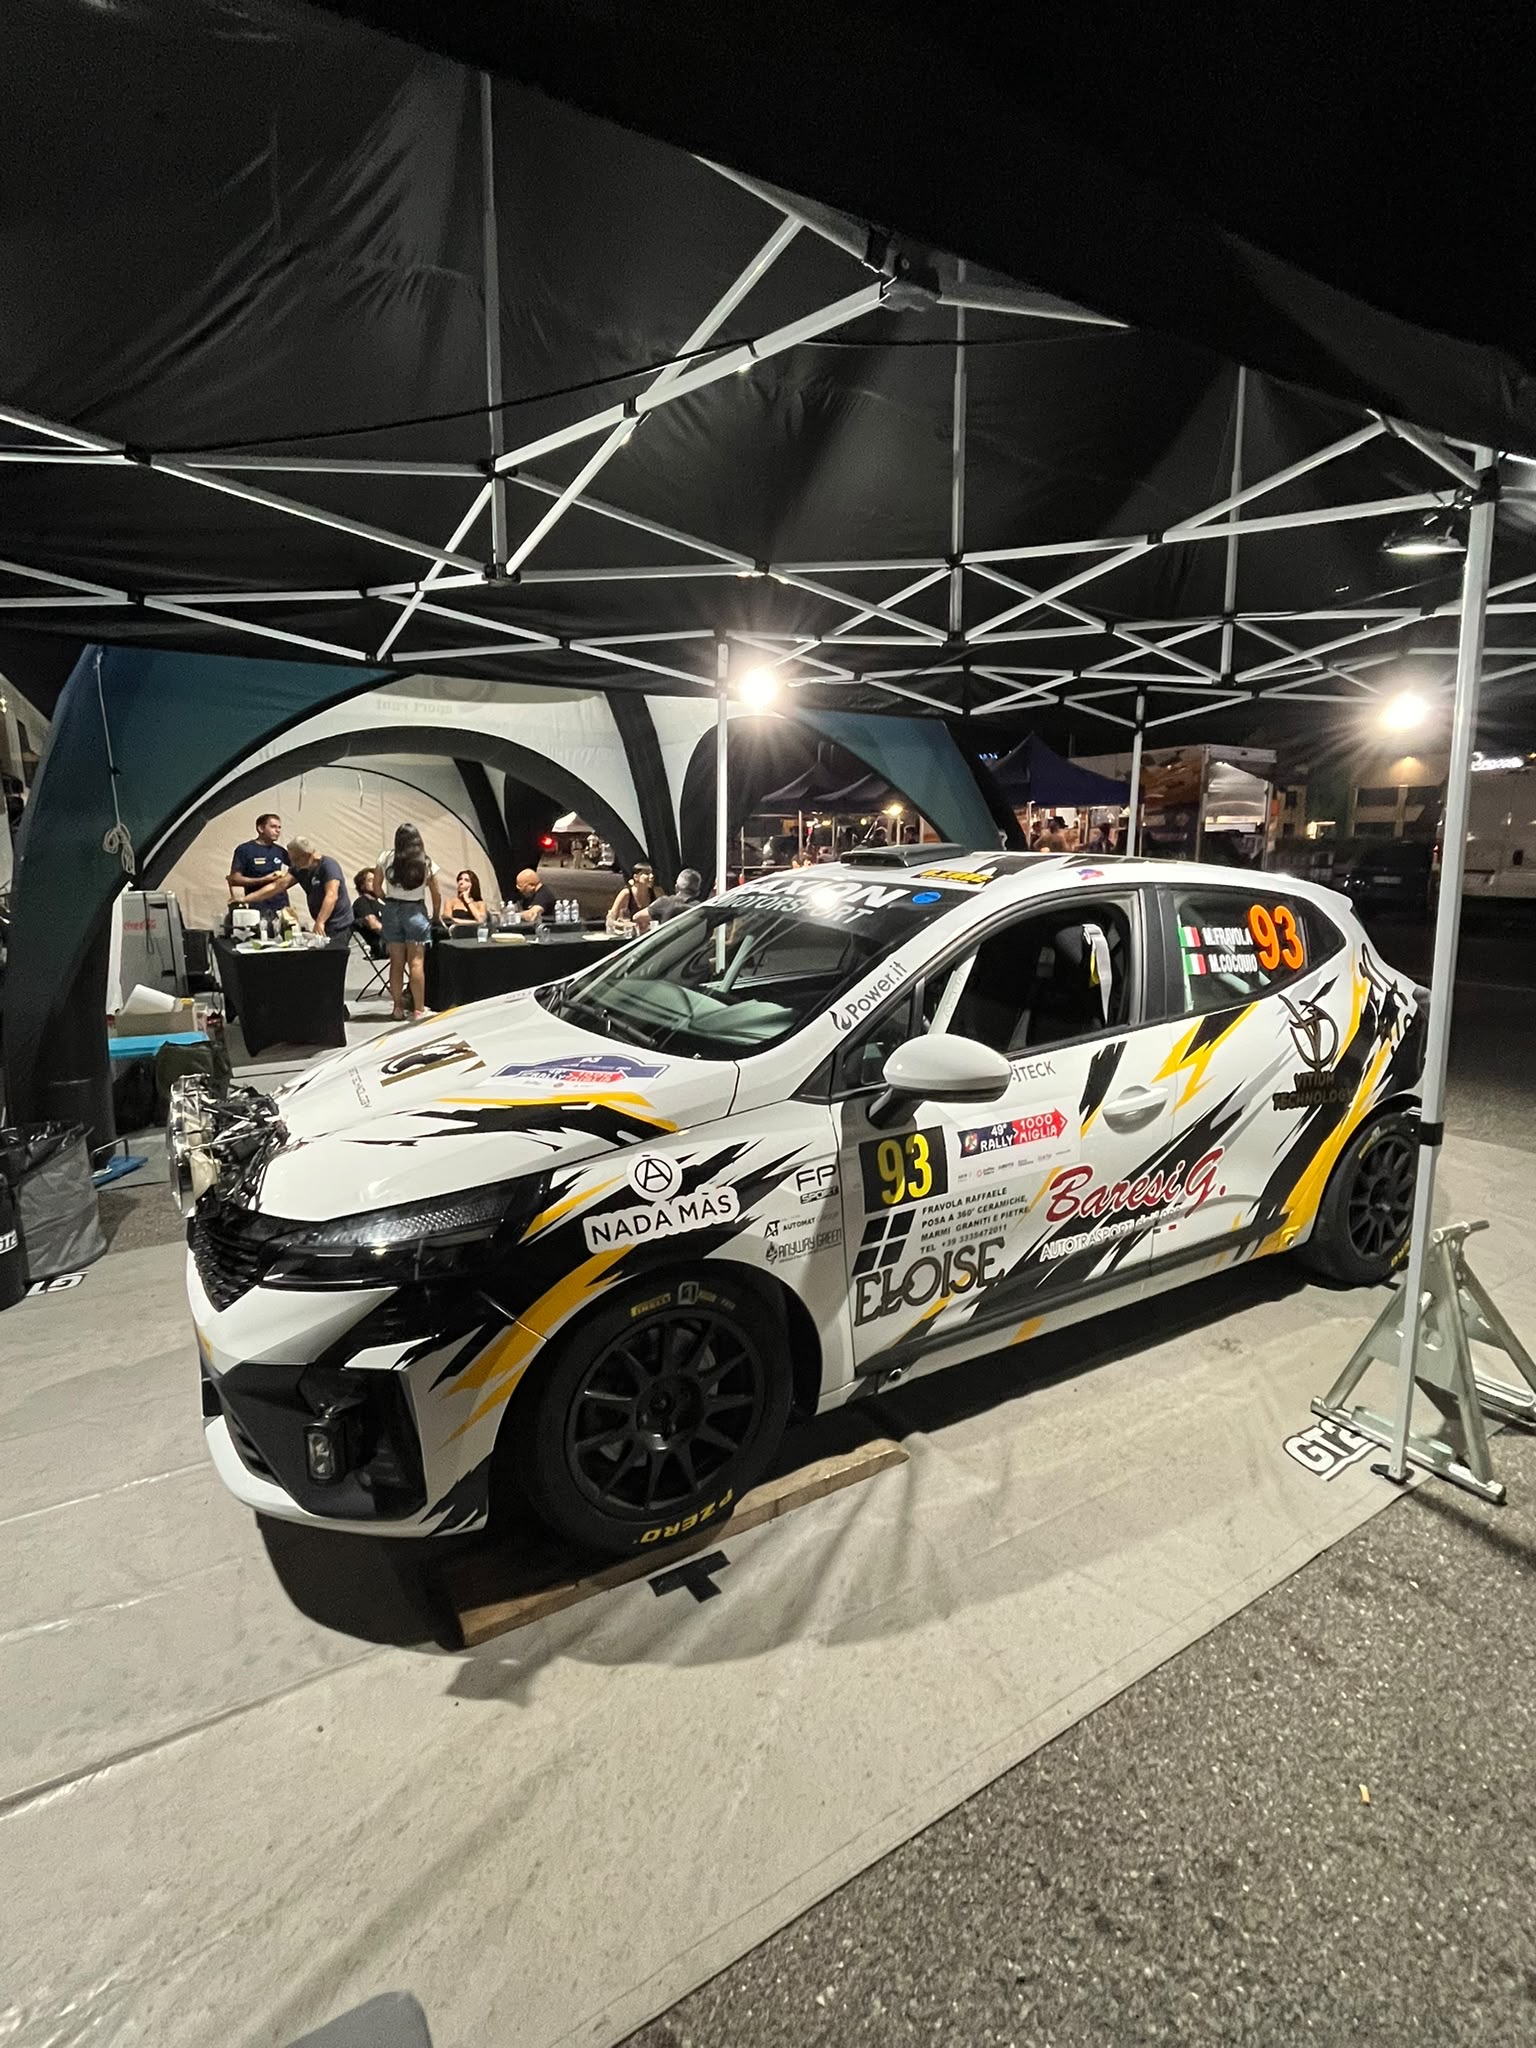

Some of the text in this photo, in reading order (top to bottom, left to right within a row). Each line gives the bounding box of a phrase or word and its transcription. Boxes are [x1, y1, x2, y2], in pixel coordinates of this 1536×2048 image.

[1201, 927, 1254, 946] M.FRAVOLA
[1248, 904, 1304, 970] 93
[845, 961, 908, 1021] Power.it
[1020, 1114, 1053, 1131] 1000
[1020, 1124, 1057, 1144] MIGLIA
[981, 1134, 1014, 1153] RALLY
[796, 1164, 836, 1192] FP
[877, 1133, 933, 1205] 93
[1046, 1146, 1228, 1222] Baresi G.
[922, 1187, 1007, 1215] FRAVOLA RAFFAELE
[591, 1209, 673, 1245] NADA
[920, 1227, 952, 1242] MARMI
[956, 1217, 991, 1232] GRANITI
[993, 1214, 999, 1222] E
[921, 1216, 946, 1229] POSA
[948, 1214, 954, 1222] A
[920, 1244, 936, 1255] TEL
[1039, 1218, 1136, 1263] AUTOTRASPORTI
[854, 1237, 1006, 1328] ELOISE
